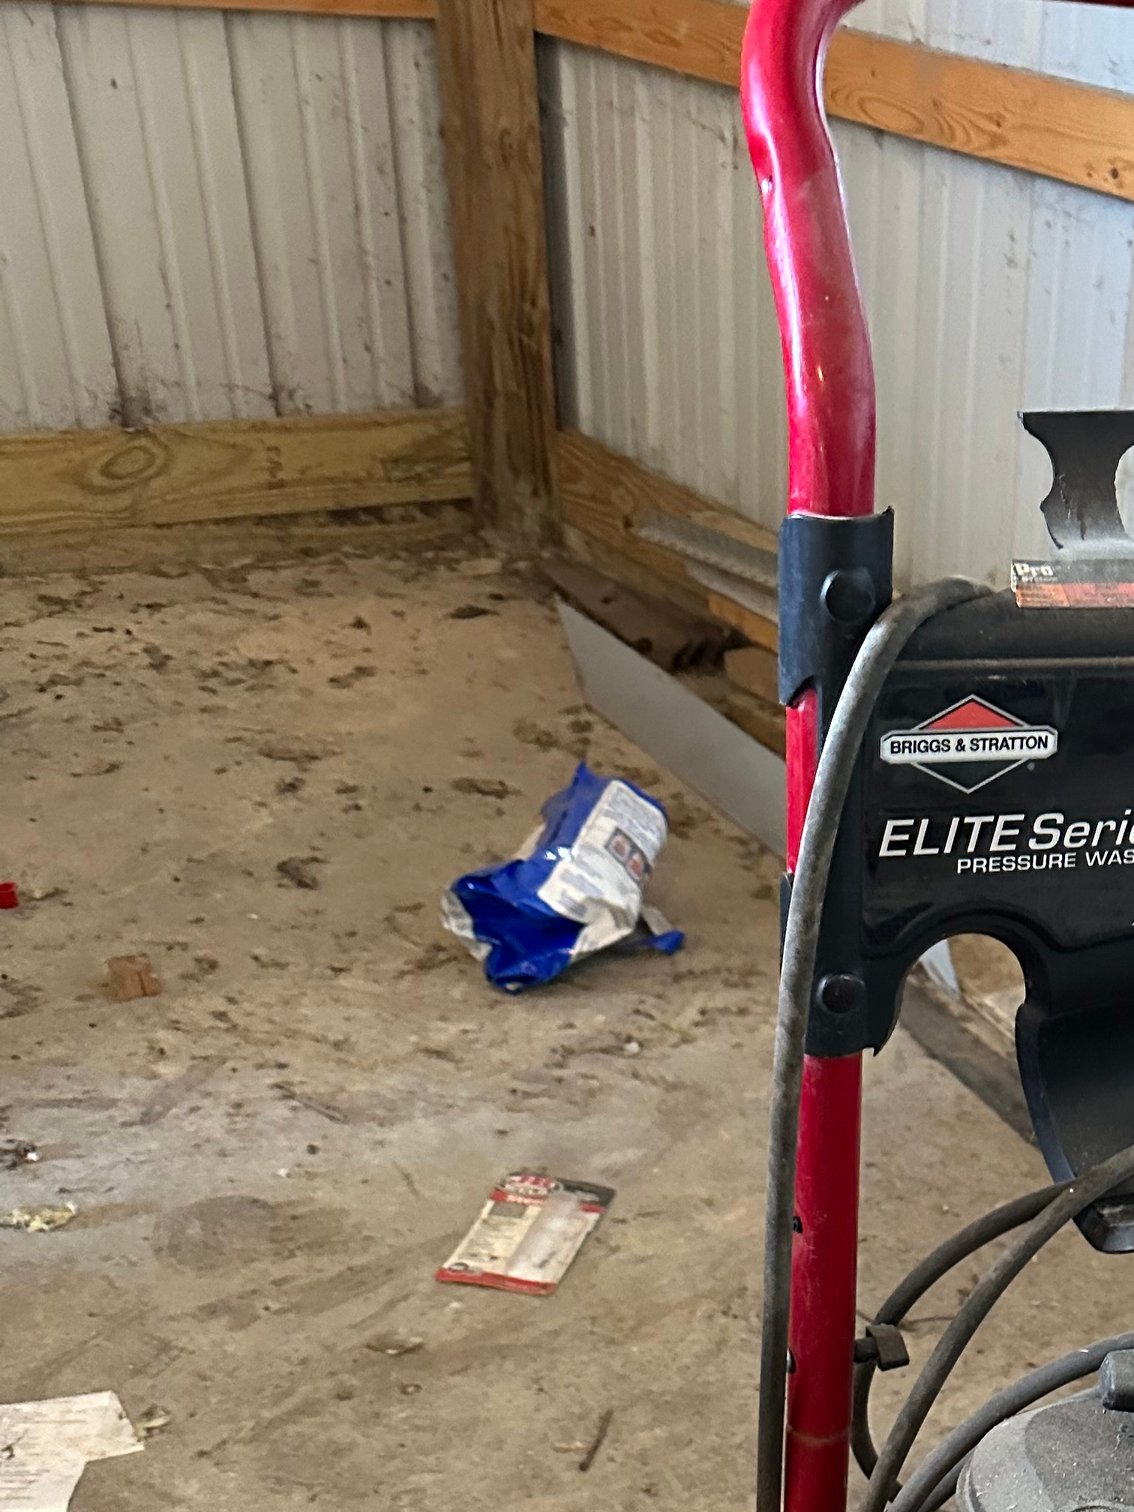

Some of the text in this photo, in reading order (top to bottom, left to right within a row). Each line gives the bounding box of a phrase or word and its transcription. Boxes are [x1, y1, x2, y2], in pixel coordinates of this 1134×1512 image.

[1014, 562, 1054, 577] Pro
[889, 736, 1049, 754] BRIGGS & STRATTON
[879, 813, 1025, 857] ELITE
[957, 851, 1077, 874] PRESSURE
